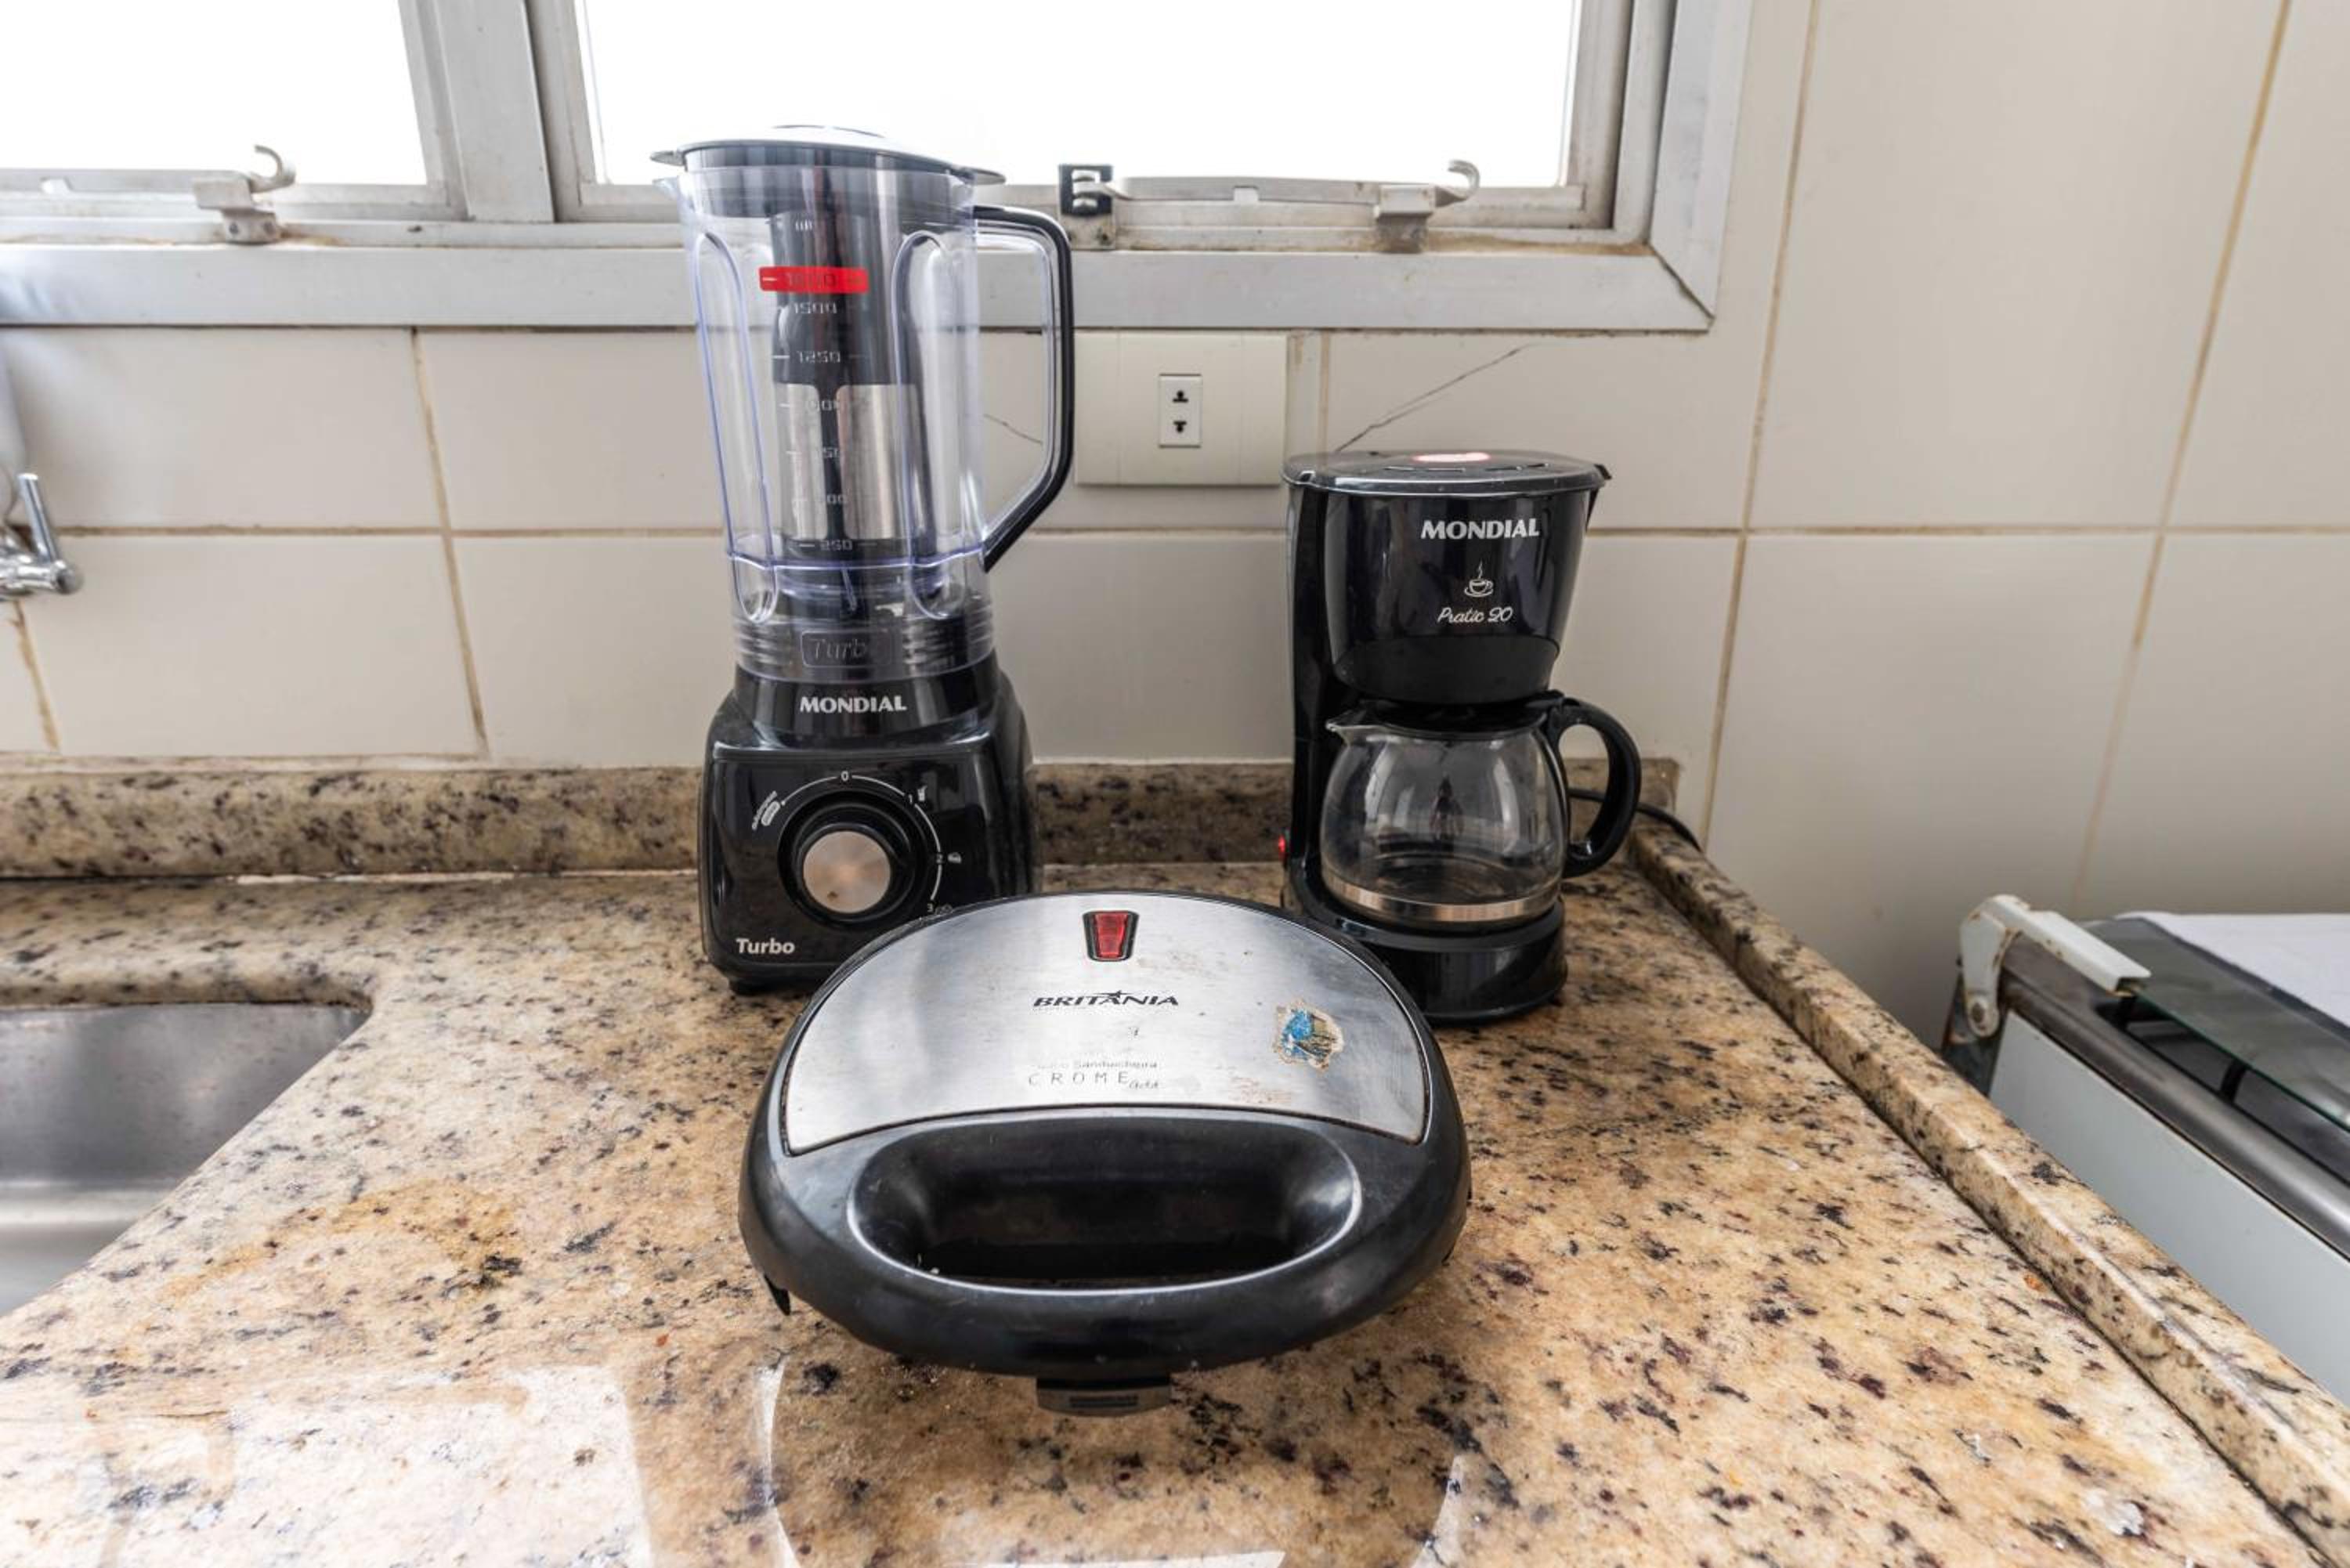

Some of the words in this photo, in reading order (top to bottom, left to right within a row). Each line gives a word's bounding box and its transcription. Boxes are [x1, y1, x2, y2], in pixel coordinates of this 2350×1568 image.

[797, 350, 841, 363] 1250
[1420, 518, 1540, 540] MONDIAL
[1437, 606, 1484, 623] Pratic
[1488, 605, 1513, 623] 20
[800, 695, 908, 714] MONDIAL
[841, 770, 849, 782] 0
[927, 903, 935, 912] 3
[736, 938, 796, 955] Turbo
